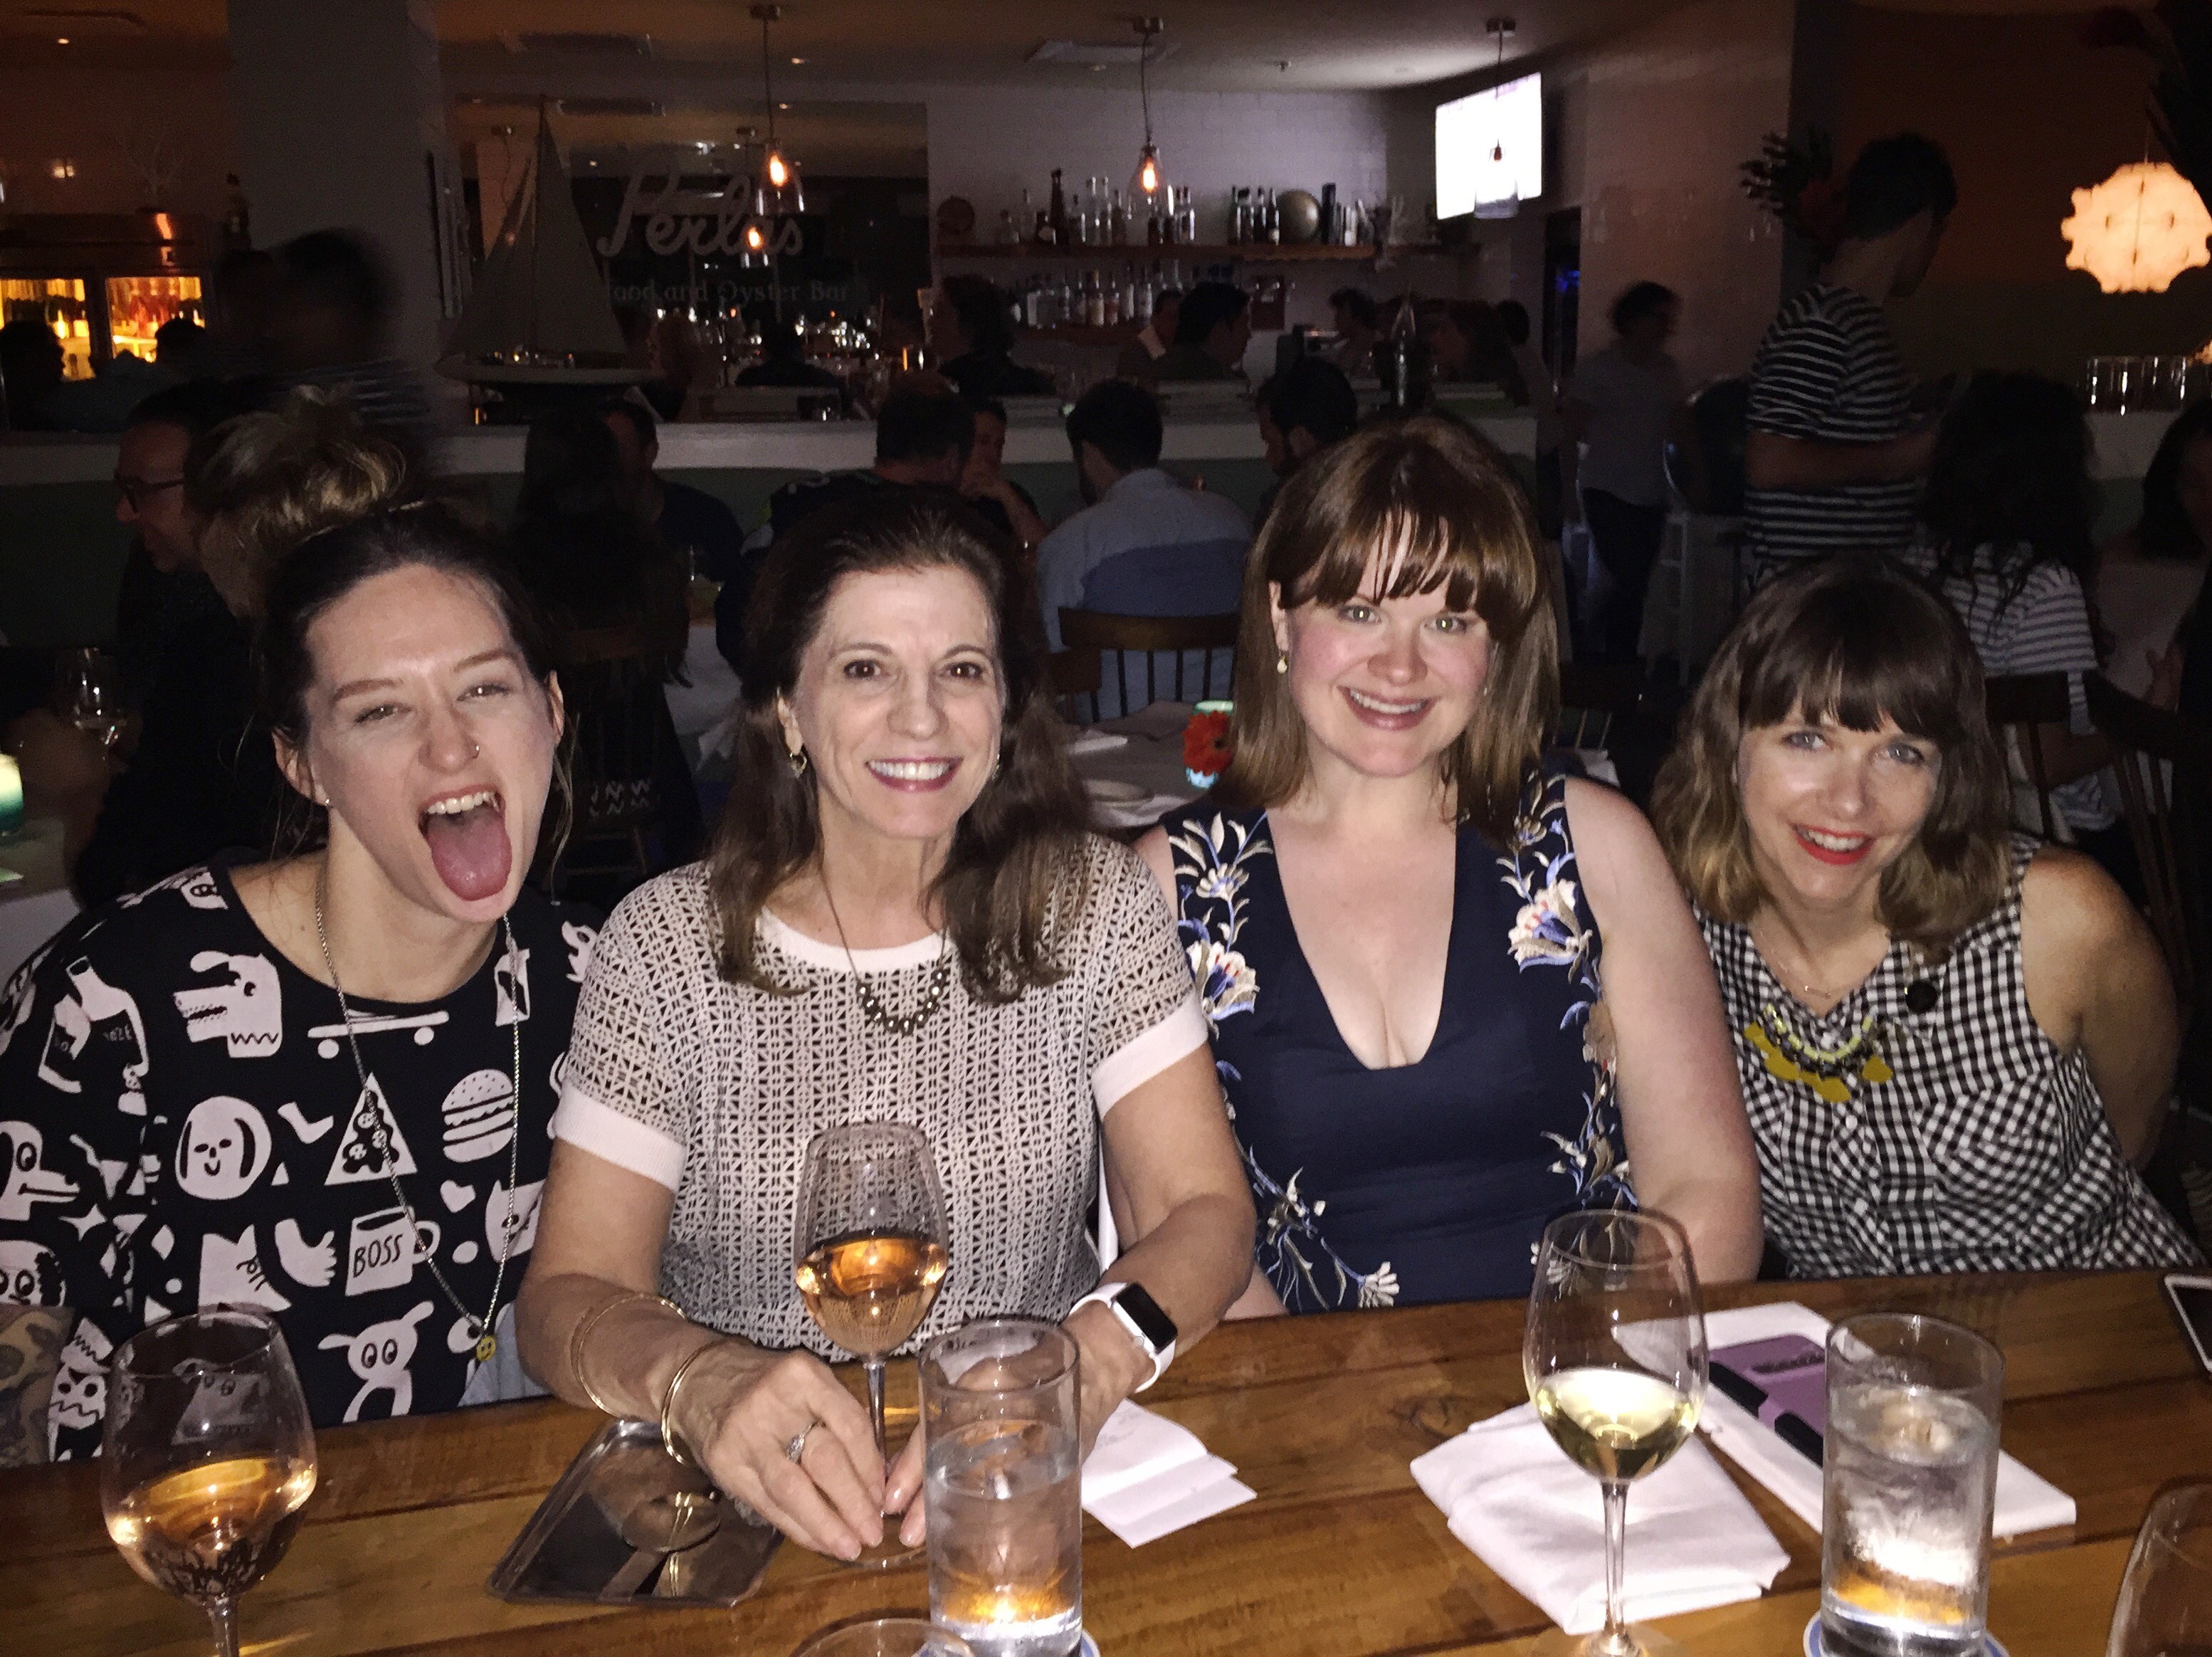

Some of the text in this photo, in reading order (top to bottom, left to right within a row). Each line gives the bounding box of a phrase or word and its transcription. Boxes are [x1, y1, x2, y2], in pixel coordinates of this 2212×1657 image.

[663, 278, 709, 302] and
[809, 278, 849, 302] Bar
[353, 1233, 404, 1278] BOSS
